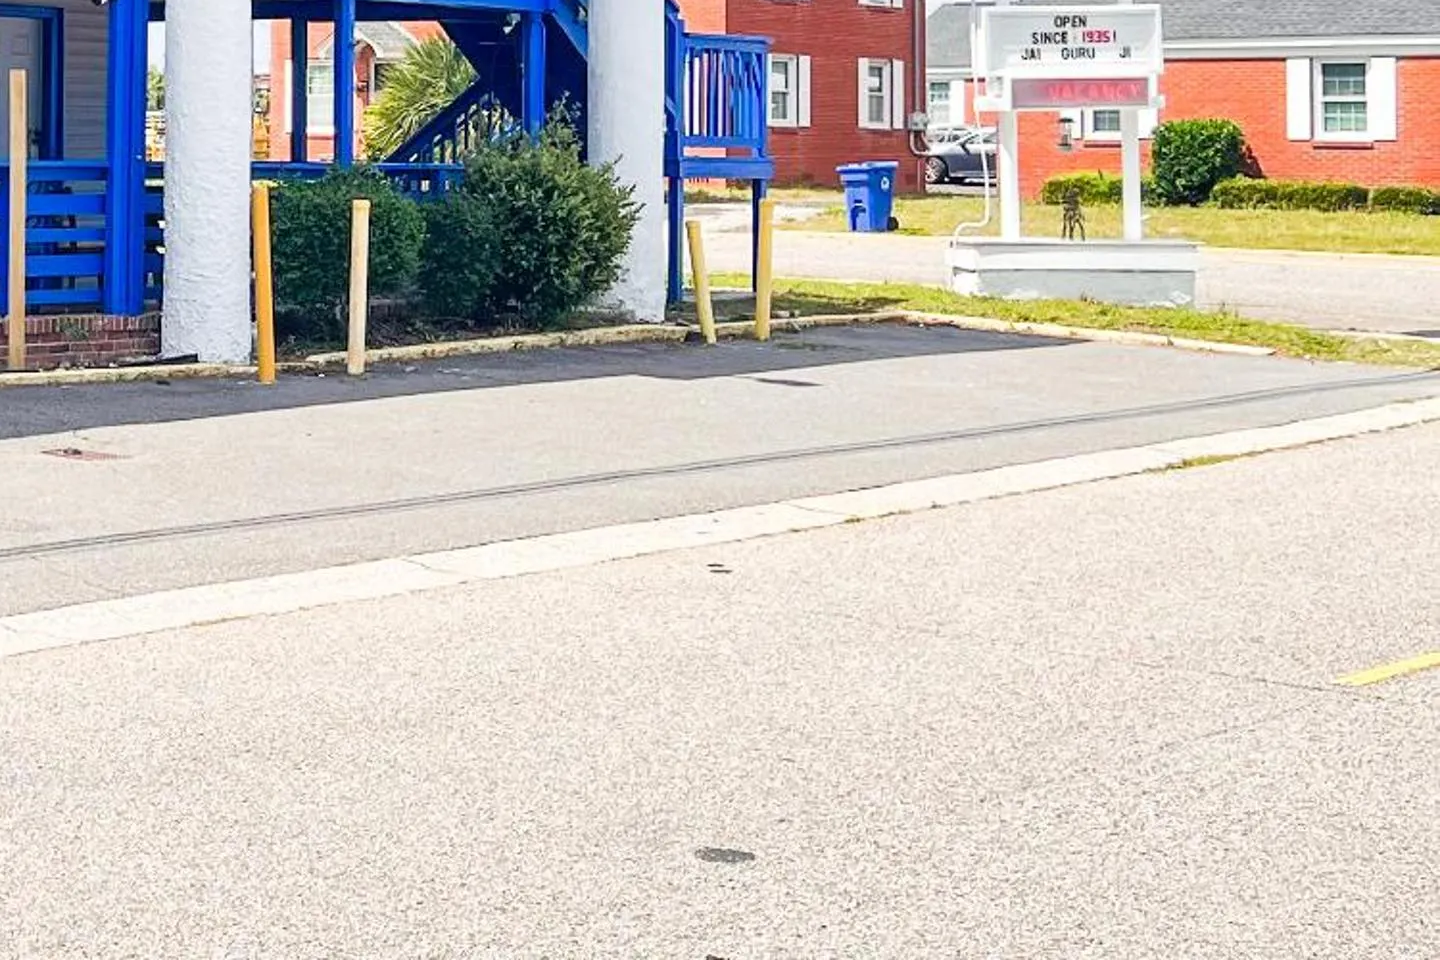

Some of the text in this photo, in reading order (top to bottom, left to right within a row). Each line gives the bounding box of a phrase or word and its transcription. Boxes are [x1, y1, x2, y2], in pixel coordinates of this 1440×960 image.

[1053, 14, 1088, 28] OPEN
[1031, 30, 1069, 45] SINCE
[1060, 46, 1096, 60] GURU
